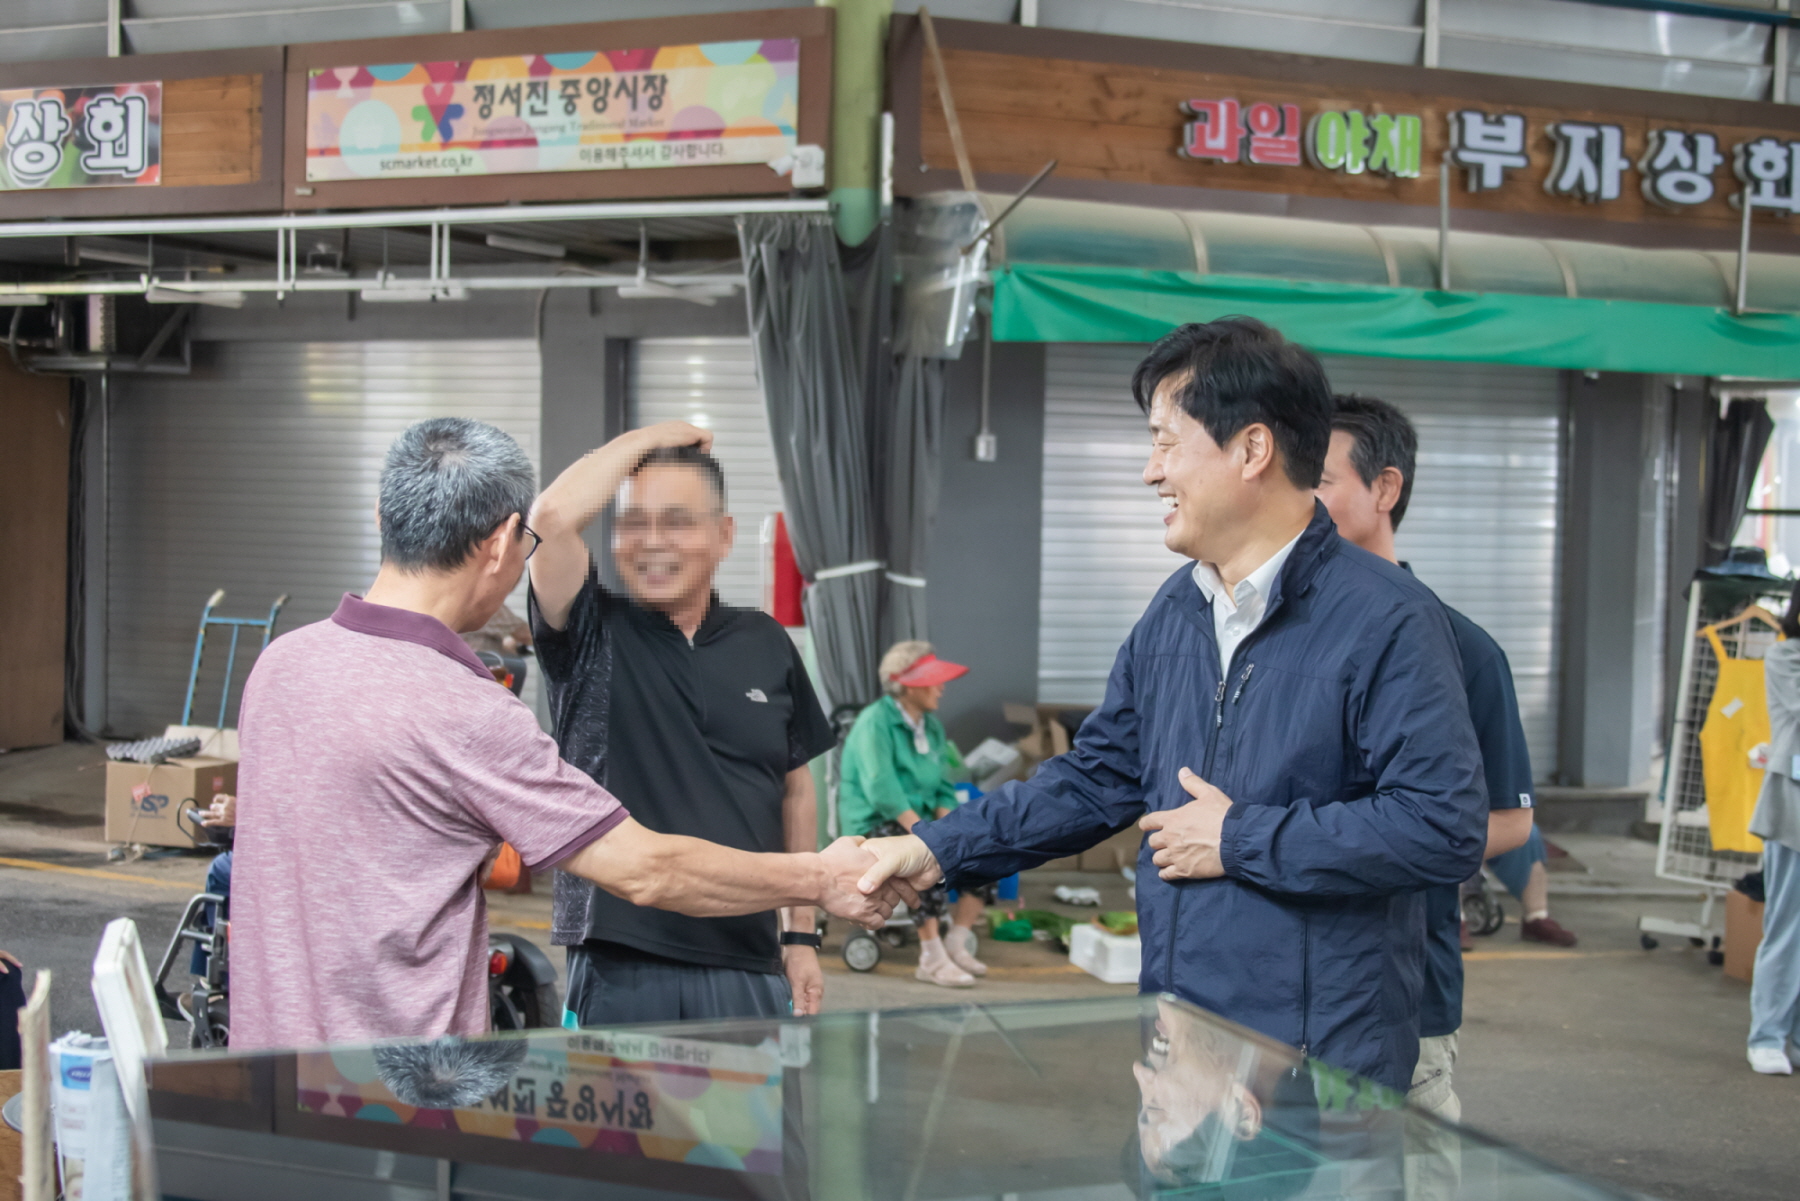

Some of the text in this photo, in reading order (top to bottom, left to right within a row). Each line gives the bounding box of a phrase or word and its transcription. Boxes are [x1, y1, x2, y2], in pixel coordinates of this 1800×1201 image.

[473, 74, 668, 120] 정서진 중앙시장
[6, 95, 148, 183] 상회
[379, 154, 474, 171] scmarket.co.kr
[1186, 98, 1301, 166] 과일
[1315, 110, 1422, 178] 야채
